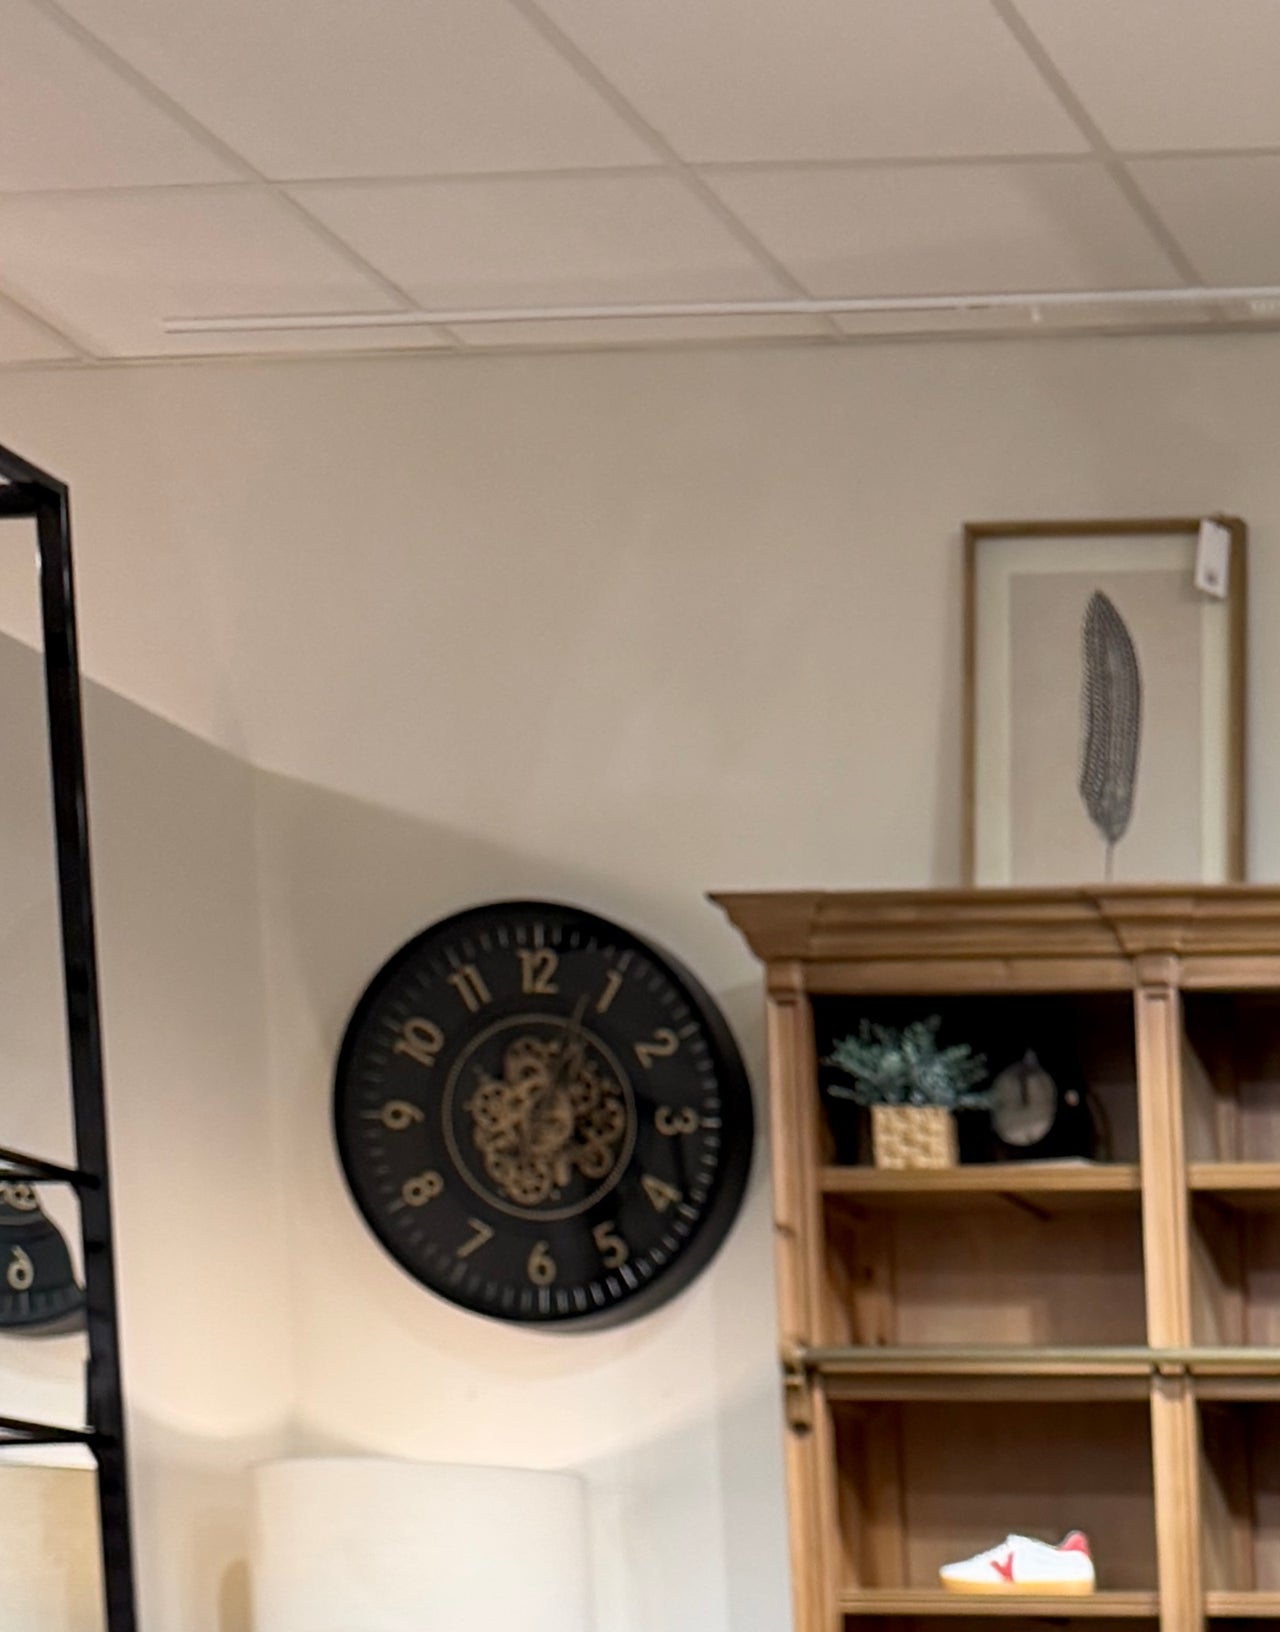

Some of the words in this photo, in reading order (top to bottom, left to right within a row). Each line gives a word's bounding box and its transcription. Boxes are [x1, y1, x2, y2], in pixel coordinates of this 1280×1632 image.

[450, 965, 492, 1011] 11
[519, 949, 558, 995] 12
[596, 971, 623, 1013] 1
[395, 1018, 444, 1065] 10
[636, 1029, 678, 1069] 2
[380, 1101, 424, 1130] 9
[657, 1106, 698, 1135] 3
[402, 1170, 444, 1206] 8
[642, 1176, 682, 1212] 4
[458, 1219, 493, 1258] 7
[594, 1222, 627, 1269] 5
[8, 1245, 34, 1289] 6
[527, 1241, 556, 1285] 6
